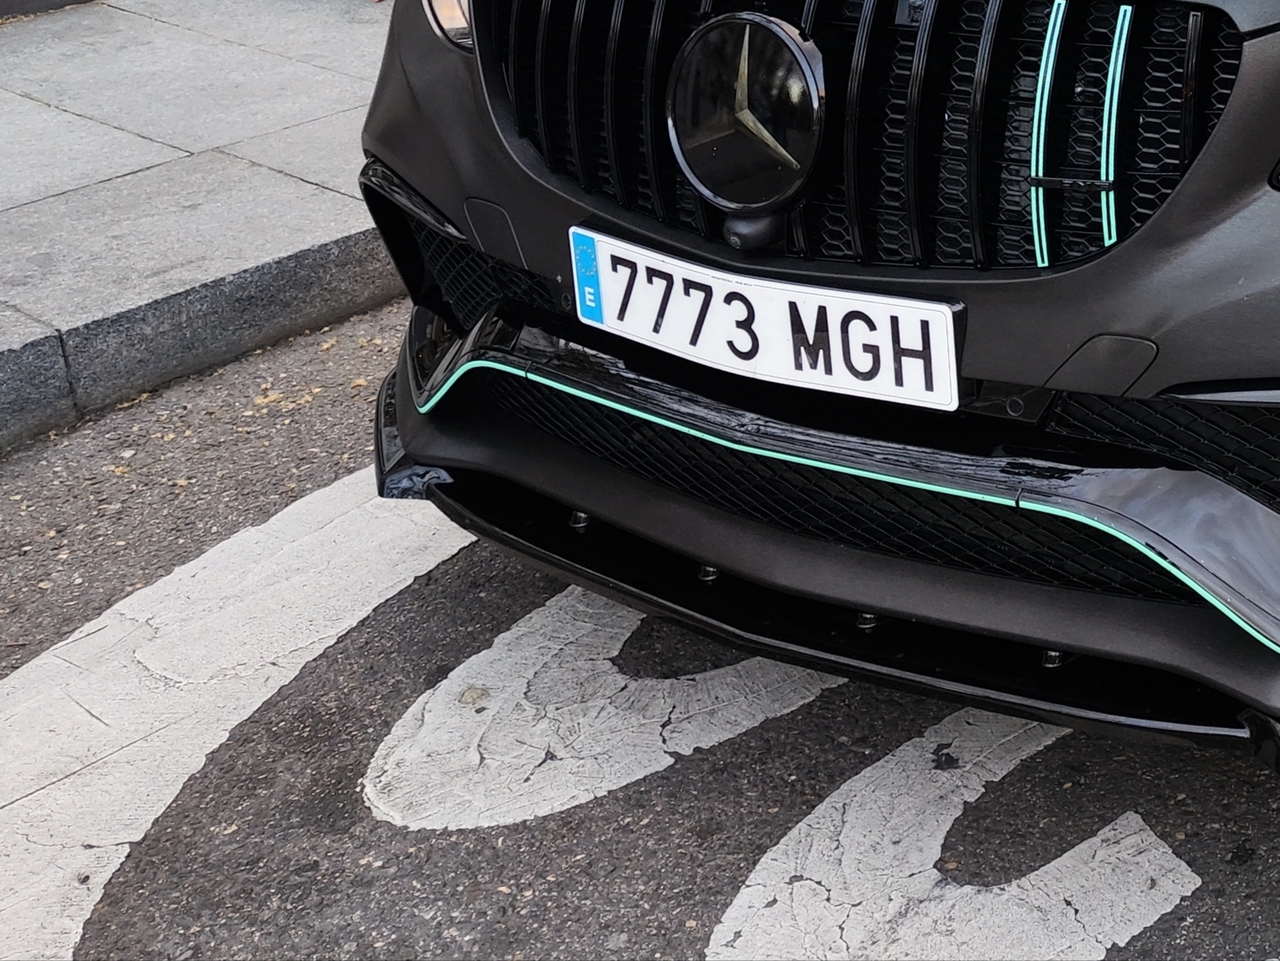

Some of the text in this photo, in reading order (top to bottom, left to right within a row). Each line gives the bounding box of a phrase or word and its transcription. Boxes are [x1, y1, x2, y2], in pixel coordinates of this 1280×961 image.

[585, 286, 595, 308] E
[610, 254, 934, 393] 7773 MGH
